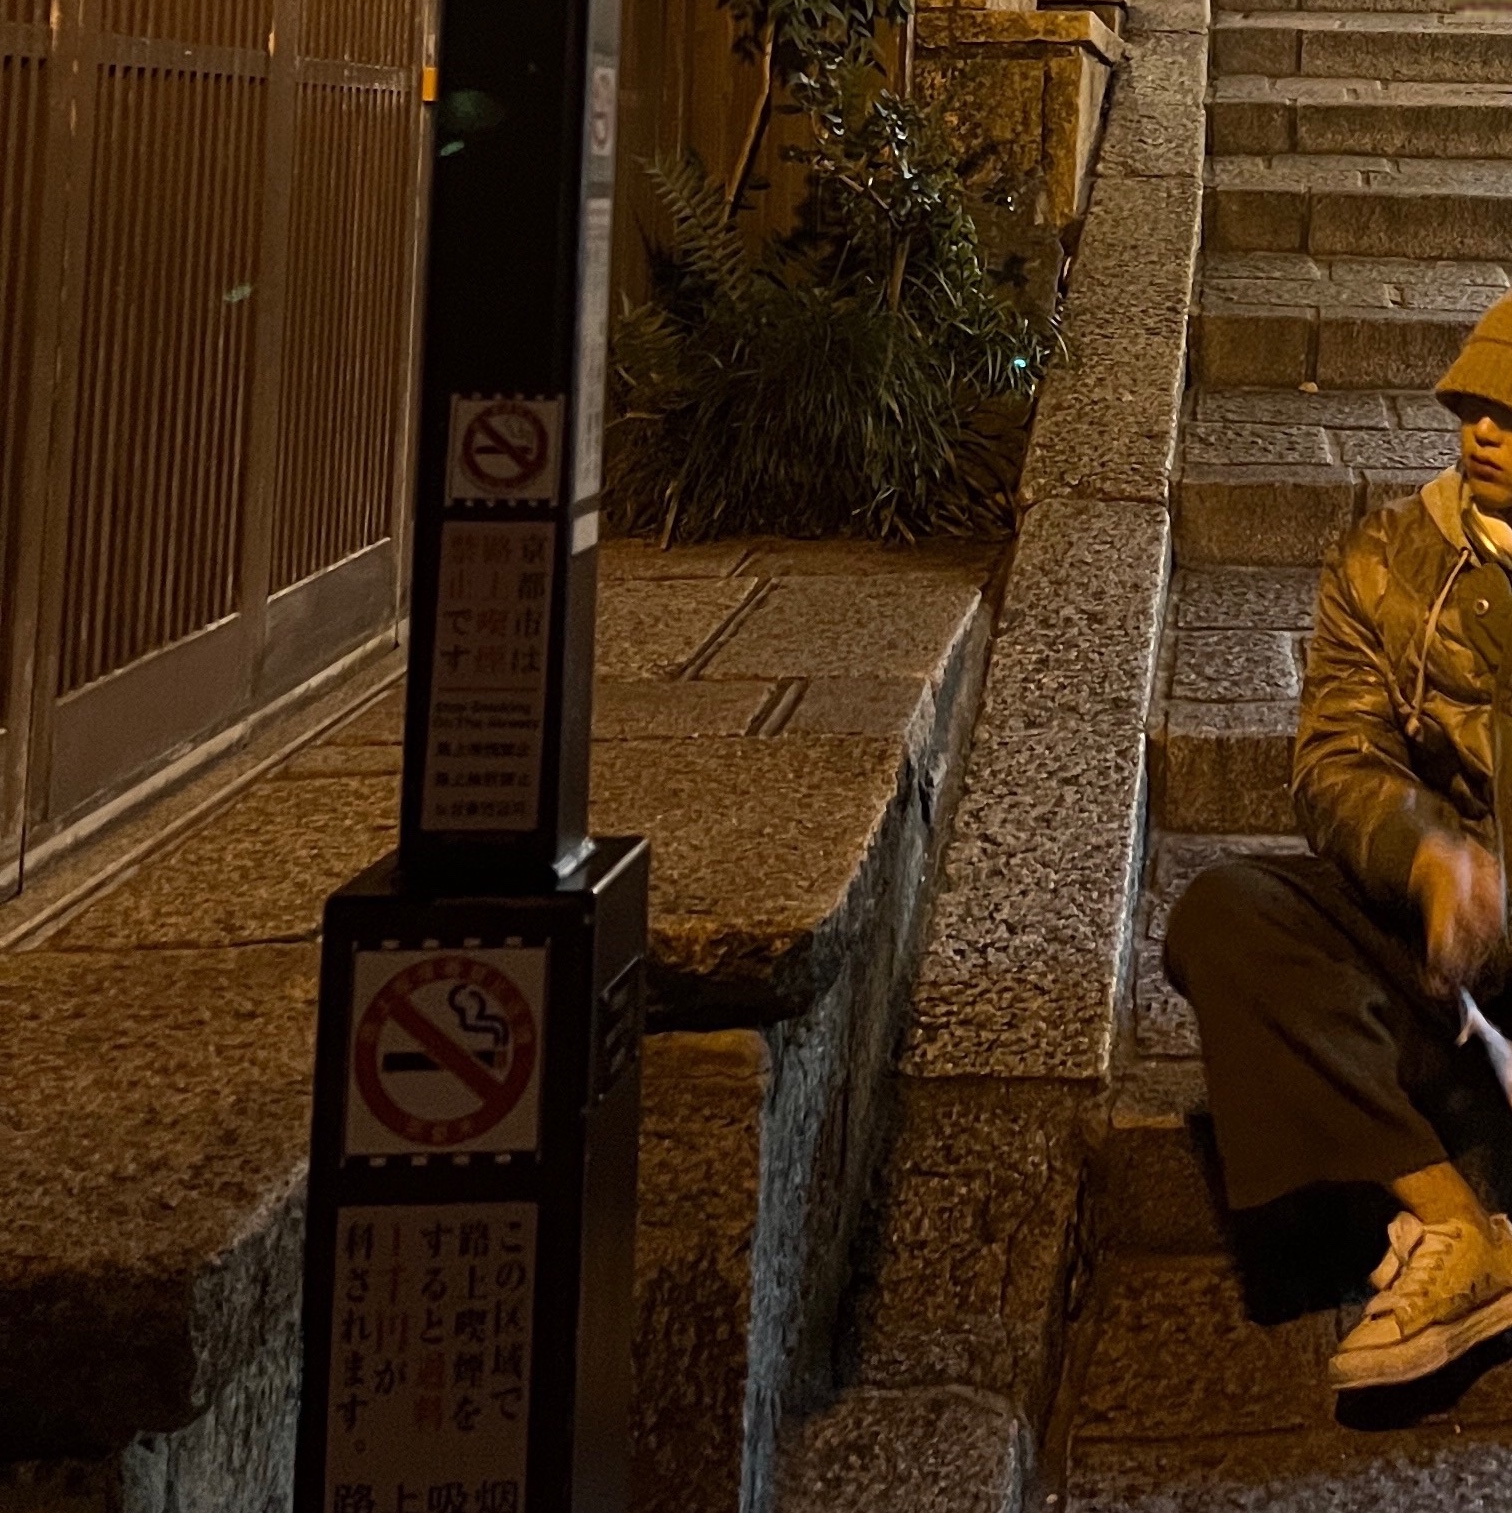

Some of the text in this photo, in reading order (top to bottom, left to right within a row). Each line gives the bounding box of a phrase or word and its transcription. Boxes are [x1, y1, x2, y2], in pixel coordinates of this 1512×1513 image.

[511, 533, 549, 675] 京都市は
[452, 1220, 491, 1433] 路上喫煙を
[490, 1220, 528, 1422] この区域で
